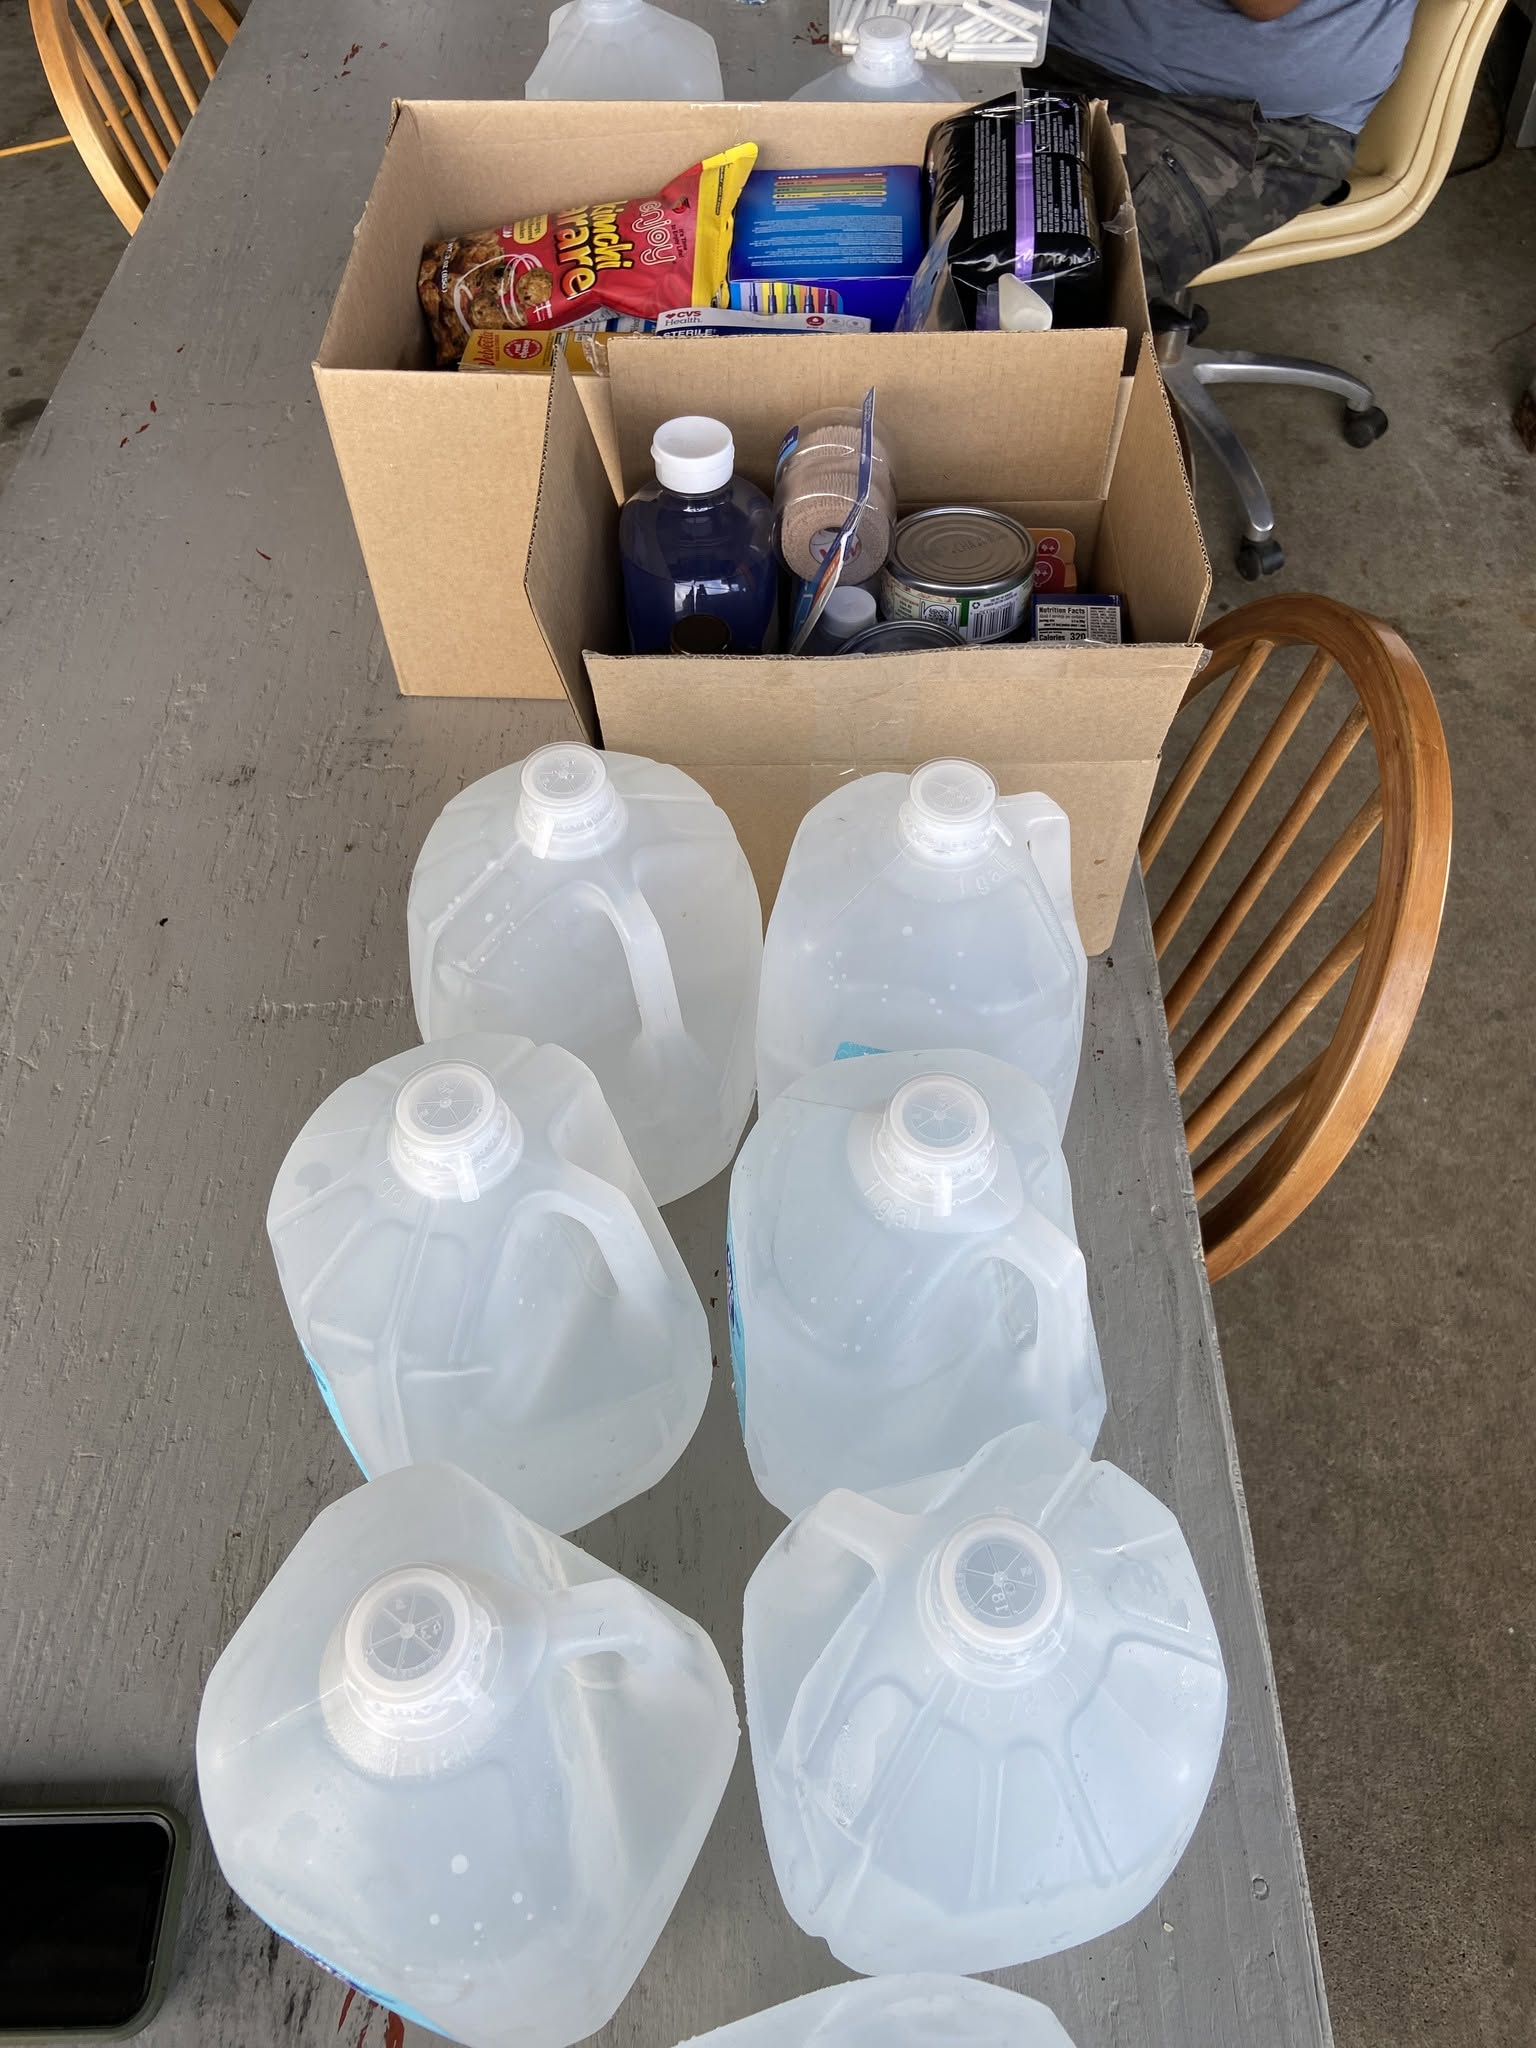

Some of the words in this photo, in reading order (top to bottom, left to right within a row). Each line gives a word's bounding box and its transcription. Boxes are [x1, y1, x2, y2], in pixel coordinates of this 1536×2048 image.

[590, 200, 634, 271] kimchi
[632, 201, 676, 266] enjoy
[677, 310, 702, 318] CVS
[473, 331, 496, 366] Velveeta
[1070, 632, 1086, 641] 320
